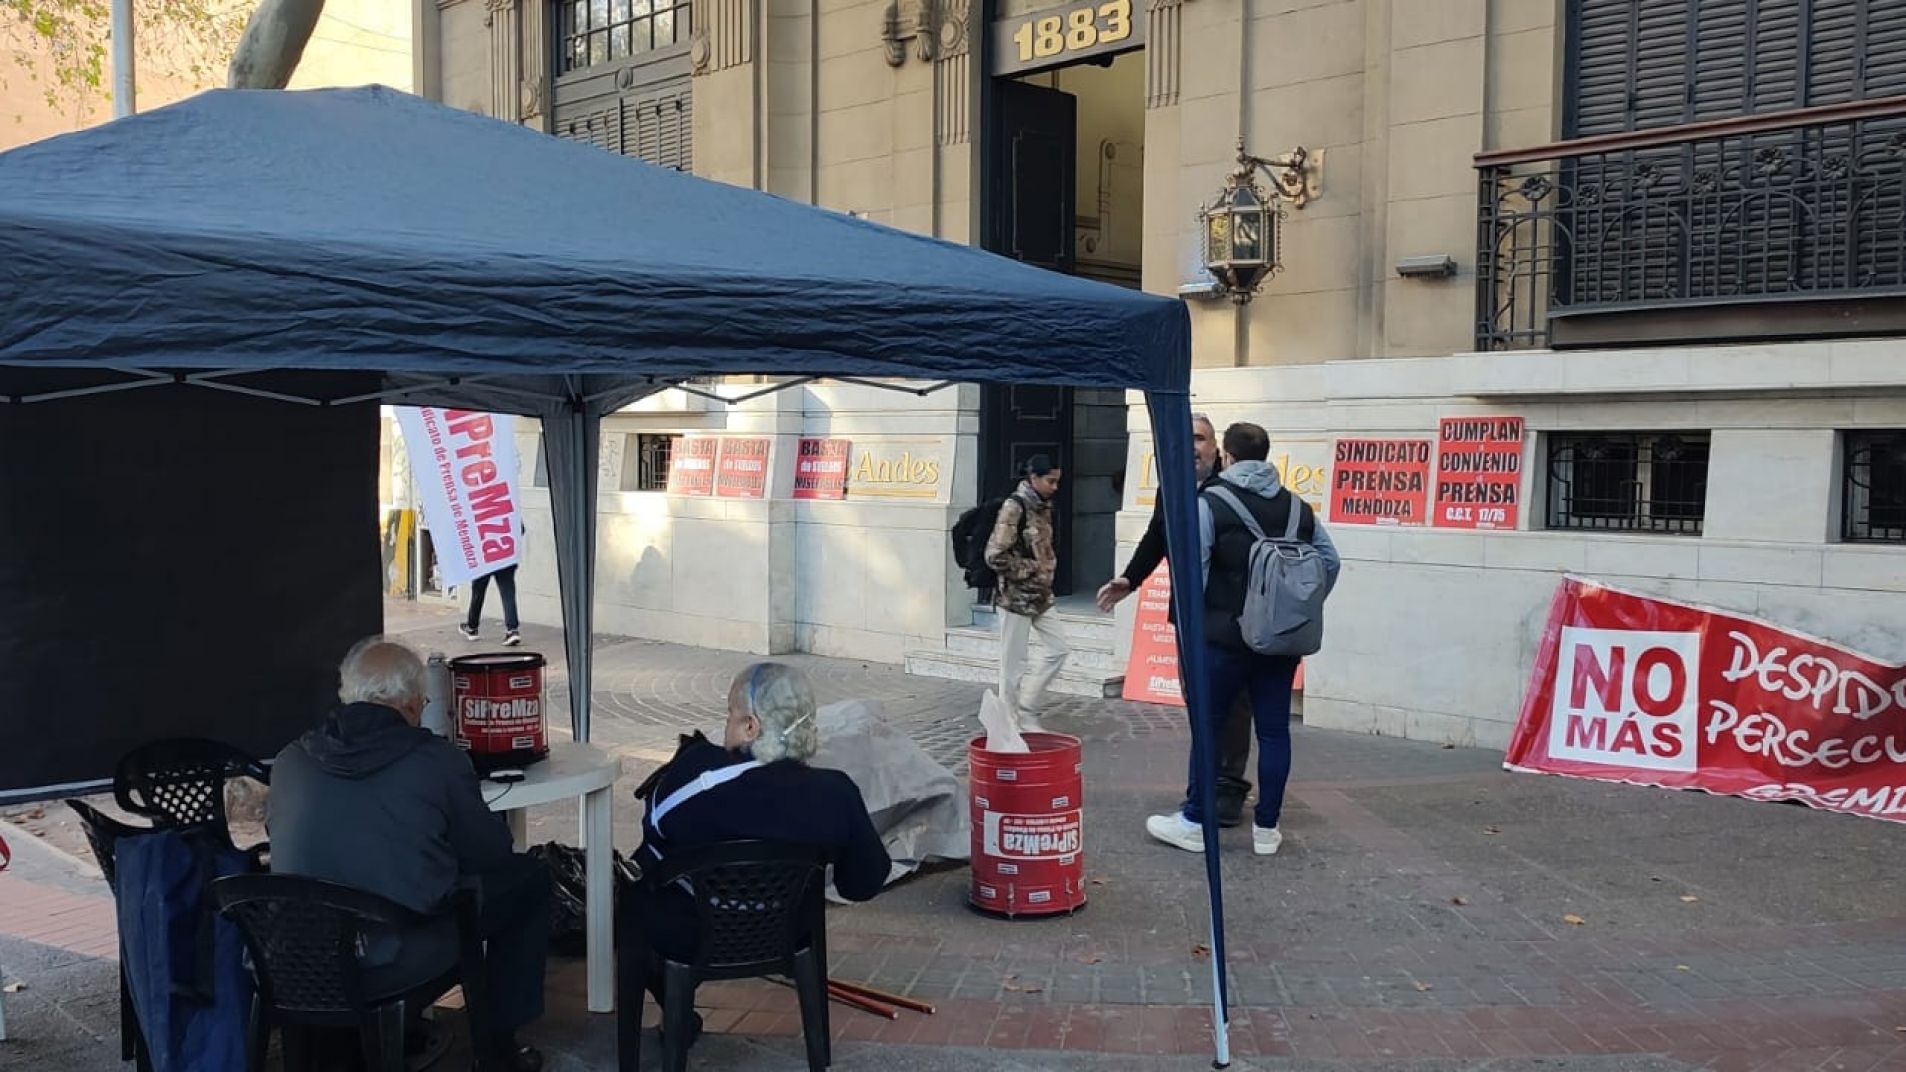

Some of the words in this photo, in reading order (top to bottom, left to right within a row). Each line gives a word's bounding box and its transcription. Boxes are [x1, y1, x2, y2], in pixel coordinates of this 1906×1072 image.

[1014, 0, 1131, 61] 1883
[1442, 422, 1520, 441] CUMPLAN
[1336, 442, 1429, 463] SINDICATO
[1440, 452, 1518, 472] CONVENIO
[855, 450, 939, 484] Andes
[1337, 470, 1422, 491] PRENSA
[1439, 482, 1515, 503] PRENSA
[1342, 498, 1411, 516] MENDOZA
[1570, 643, 1687, 717] NO
[465, 699, 539, 719] SiPreMza
[1565, 711, 1683, 758] MÁS
